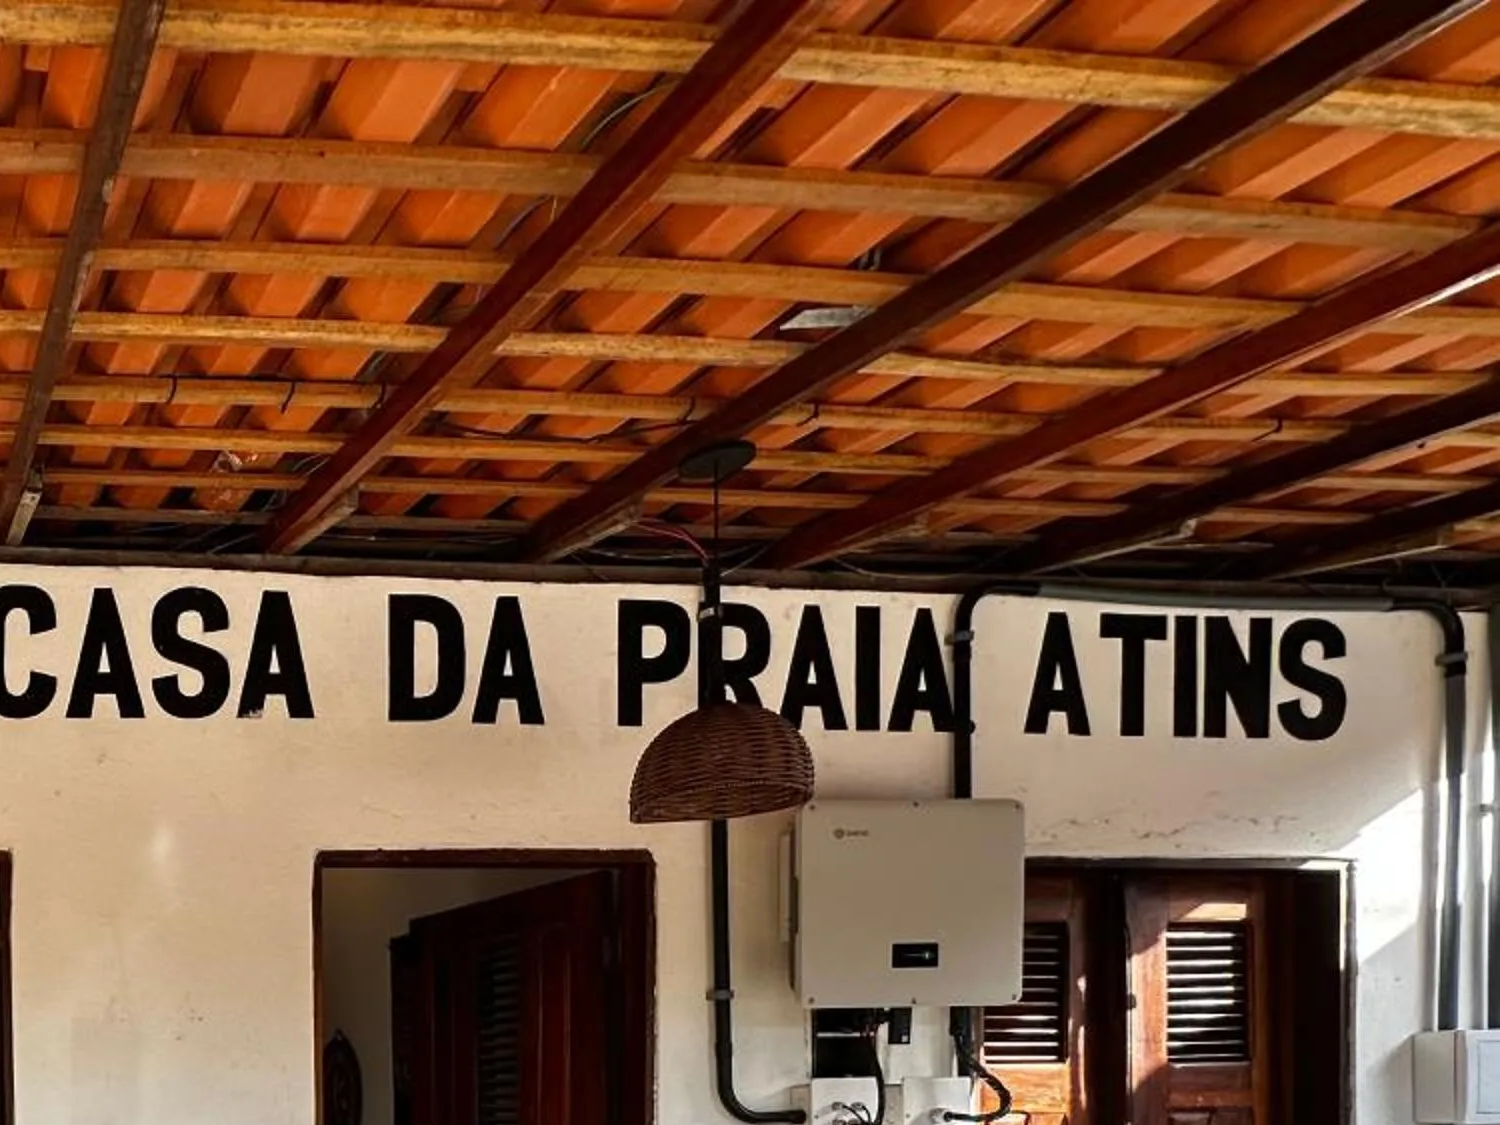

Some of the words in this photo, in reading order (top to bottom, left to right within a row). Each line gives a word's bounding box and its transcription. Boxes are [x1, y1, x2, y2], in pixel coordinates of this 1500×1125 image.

[389, 593, 545, 725] DA
[617, 599, 956, 732] PRAIA
[1023, 611, 1347, 741] ATINS
